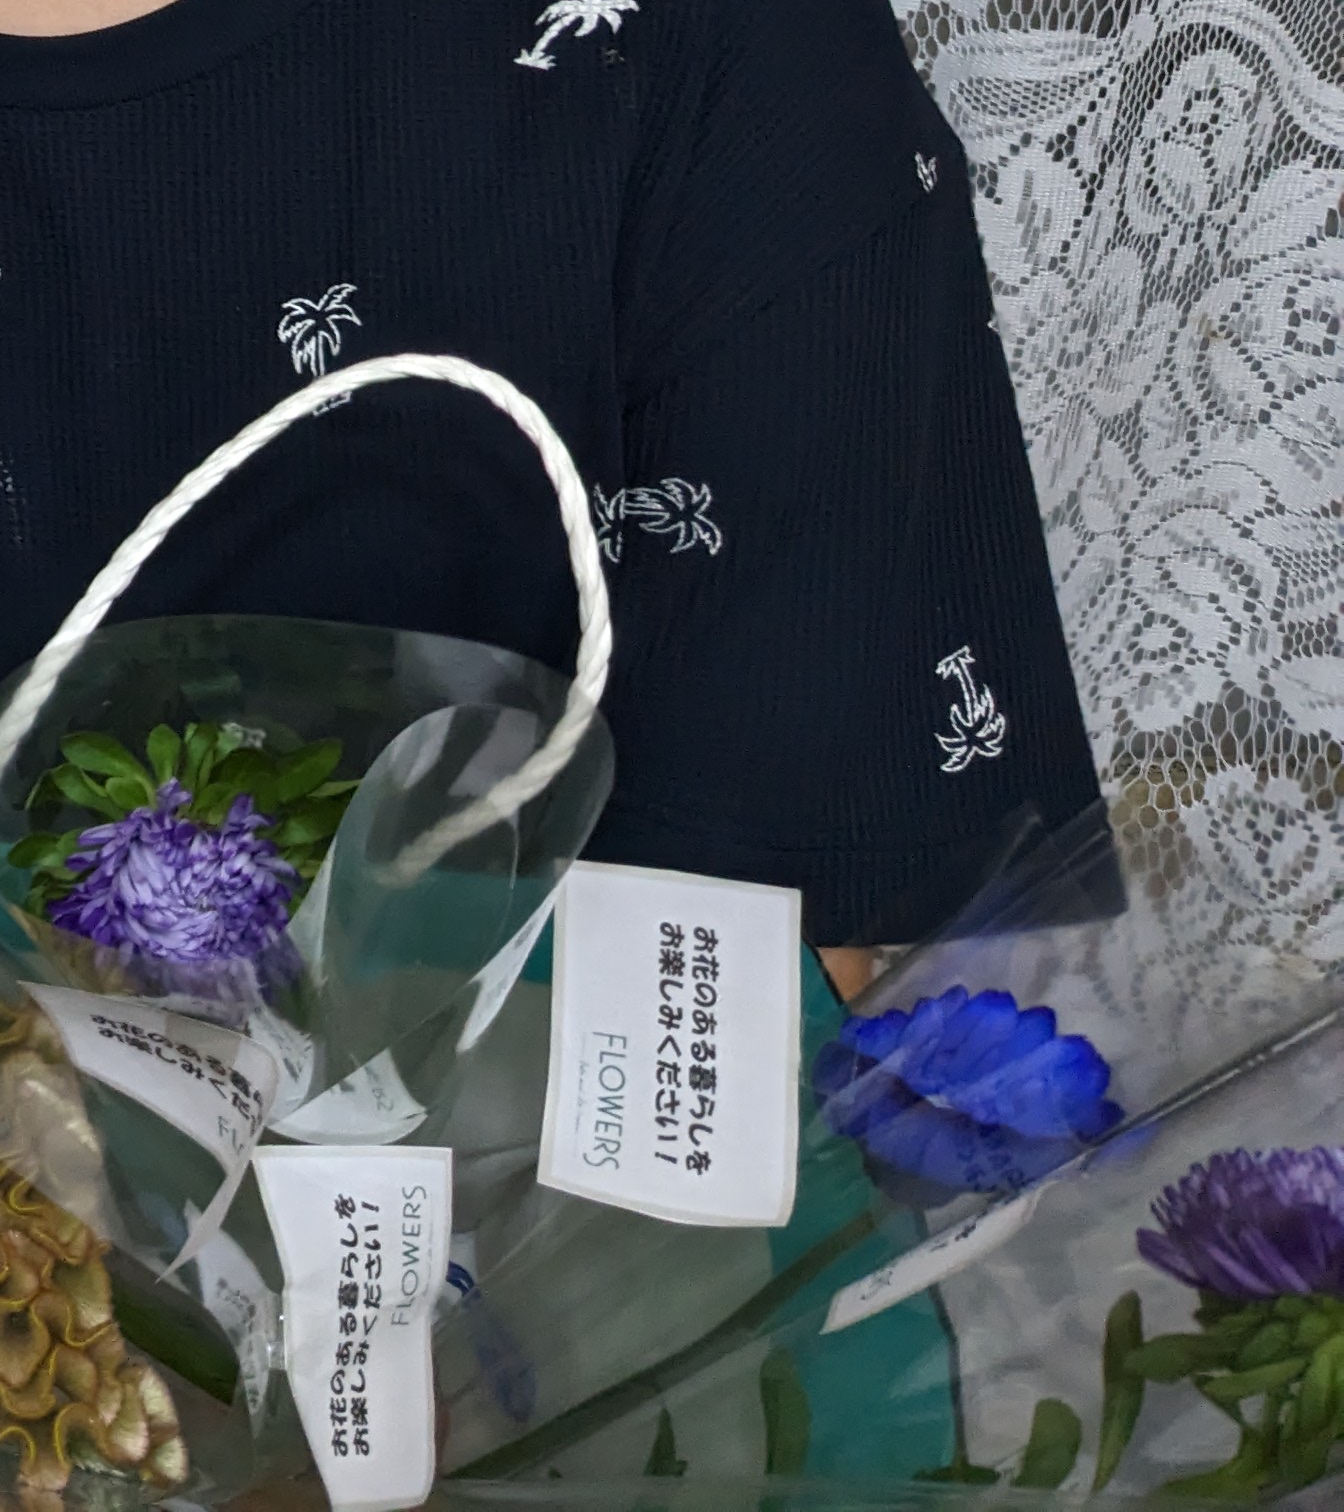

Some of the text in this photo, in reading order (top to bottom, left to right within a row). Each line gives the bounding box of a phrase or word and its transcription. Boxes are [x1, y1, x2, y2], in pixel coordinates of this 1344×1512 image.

[583, 1031, 628, 1170] FLOWERS
[655, 921, 686, 1166] お楽しみください！
[686, 926, 720, 1176] お花のある暮らしを
[330, 1193, 360, 1457] お花のある暮らしを
[353, 1201, 383, 1457] お楽しみください！
[391, 1185, 427, 1326] FLOWERS
